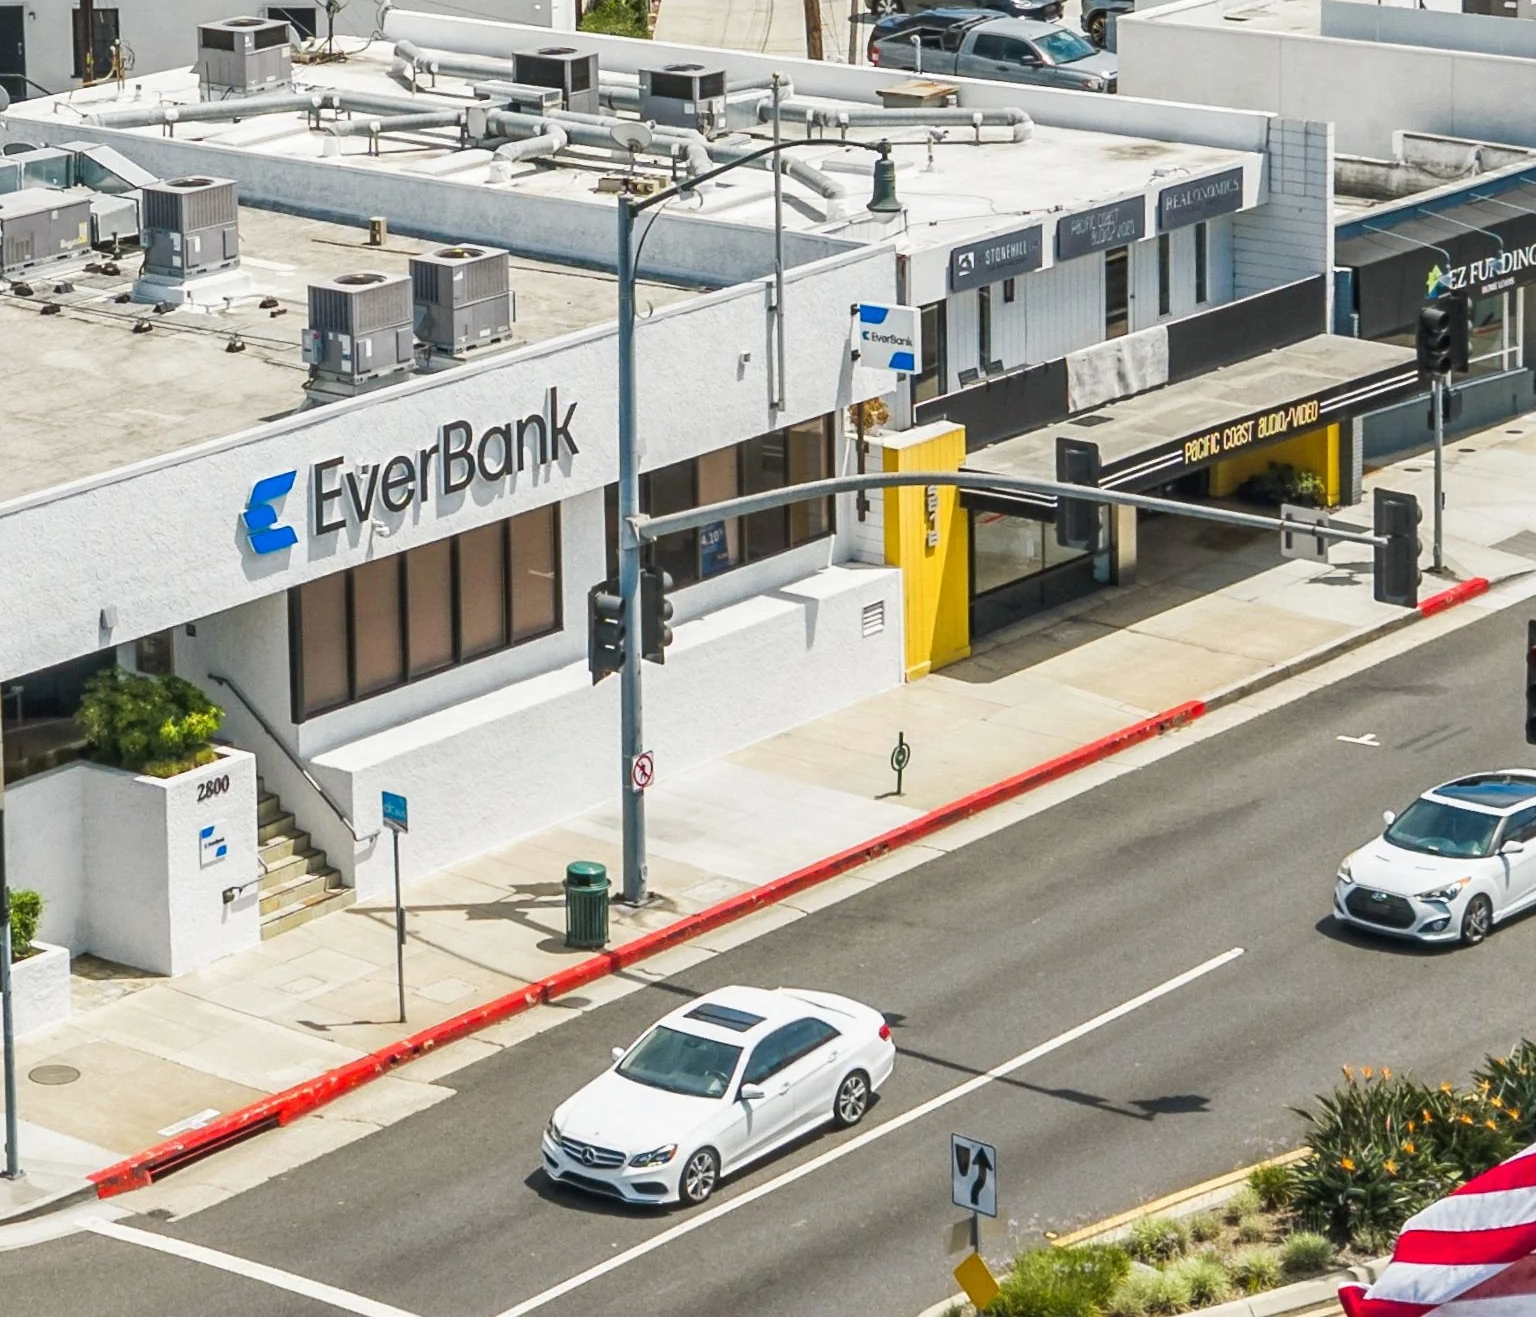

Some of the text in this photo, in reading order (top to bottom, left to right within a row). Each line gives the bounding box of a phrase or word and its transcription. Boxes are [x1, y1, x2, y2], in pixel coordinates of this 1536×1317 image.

[985, 239, 1028, 265] STONEHILL
[1449, 266, 1467, 290] EZ
[871, 331, 913, 347] EverBank
[313, 386, 580, 536] EverBank
[197, 774, 230, 802] 2800
